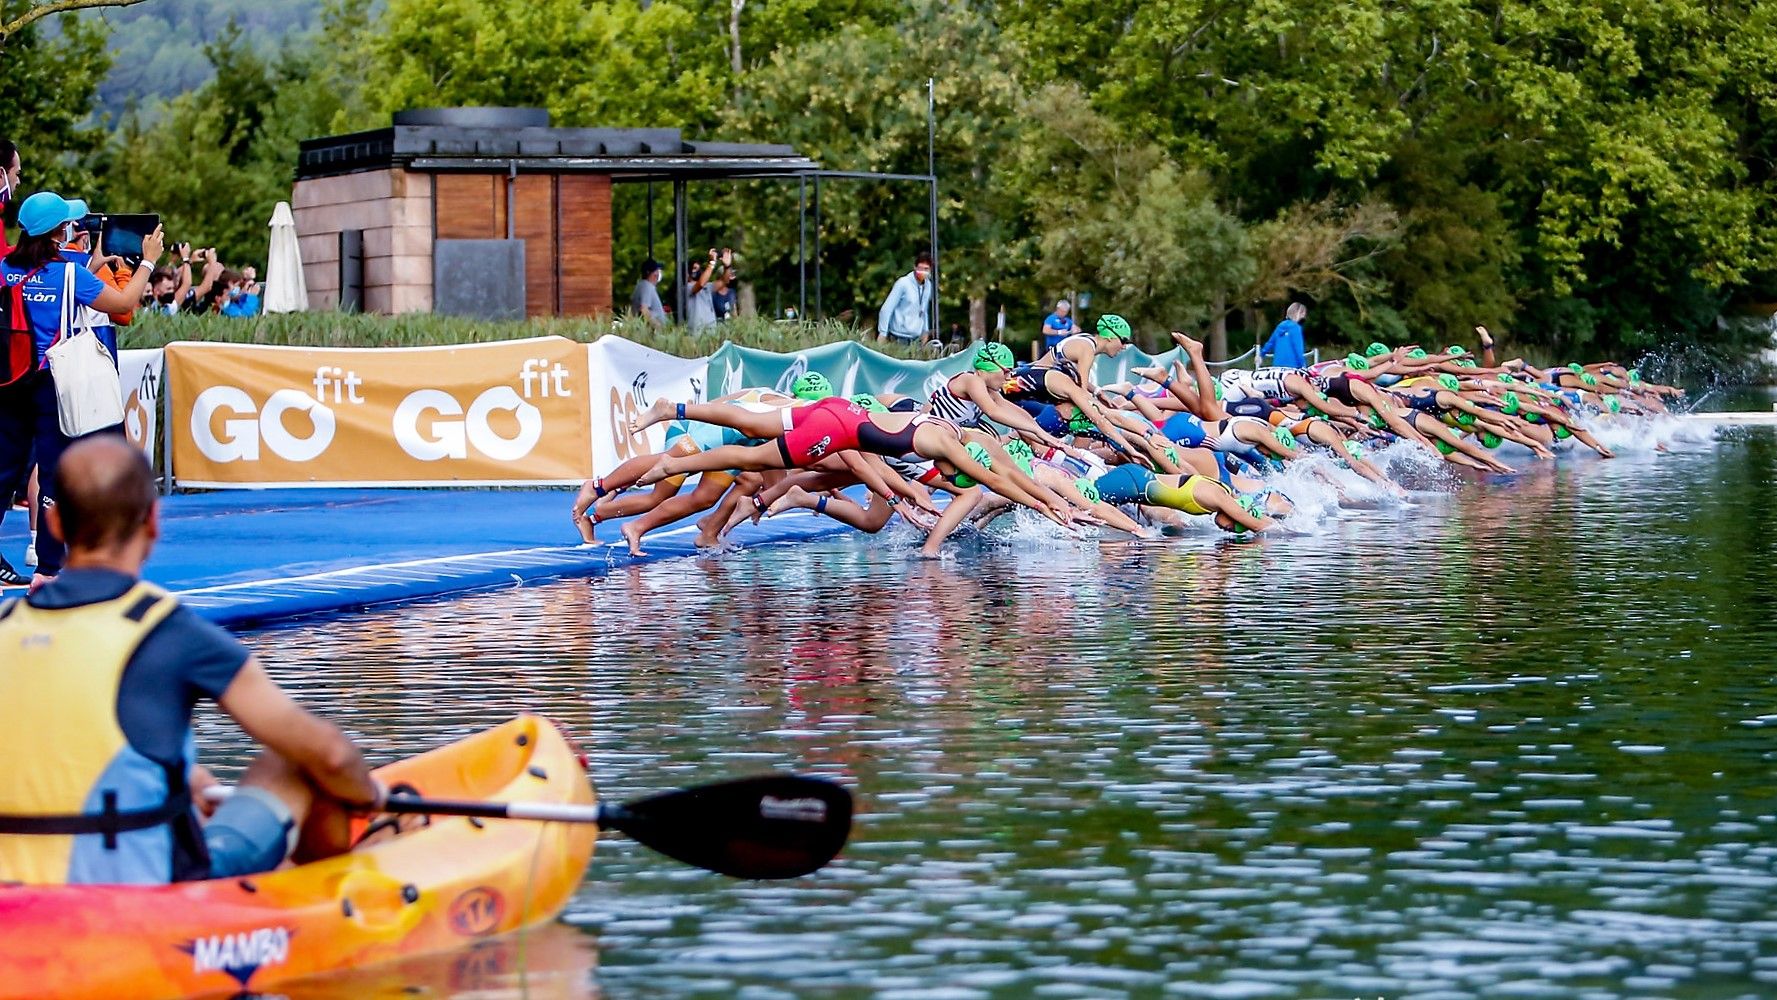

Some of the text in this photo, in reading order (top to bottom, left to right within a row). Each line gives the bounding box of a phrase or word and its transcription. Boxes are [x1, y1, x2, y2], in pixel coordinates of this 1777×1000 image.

[191, 366, 365, 463] GO fit
[392, 358, 572, 462] GO fit
[193, 926, 289, 975] MAMBO
